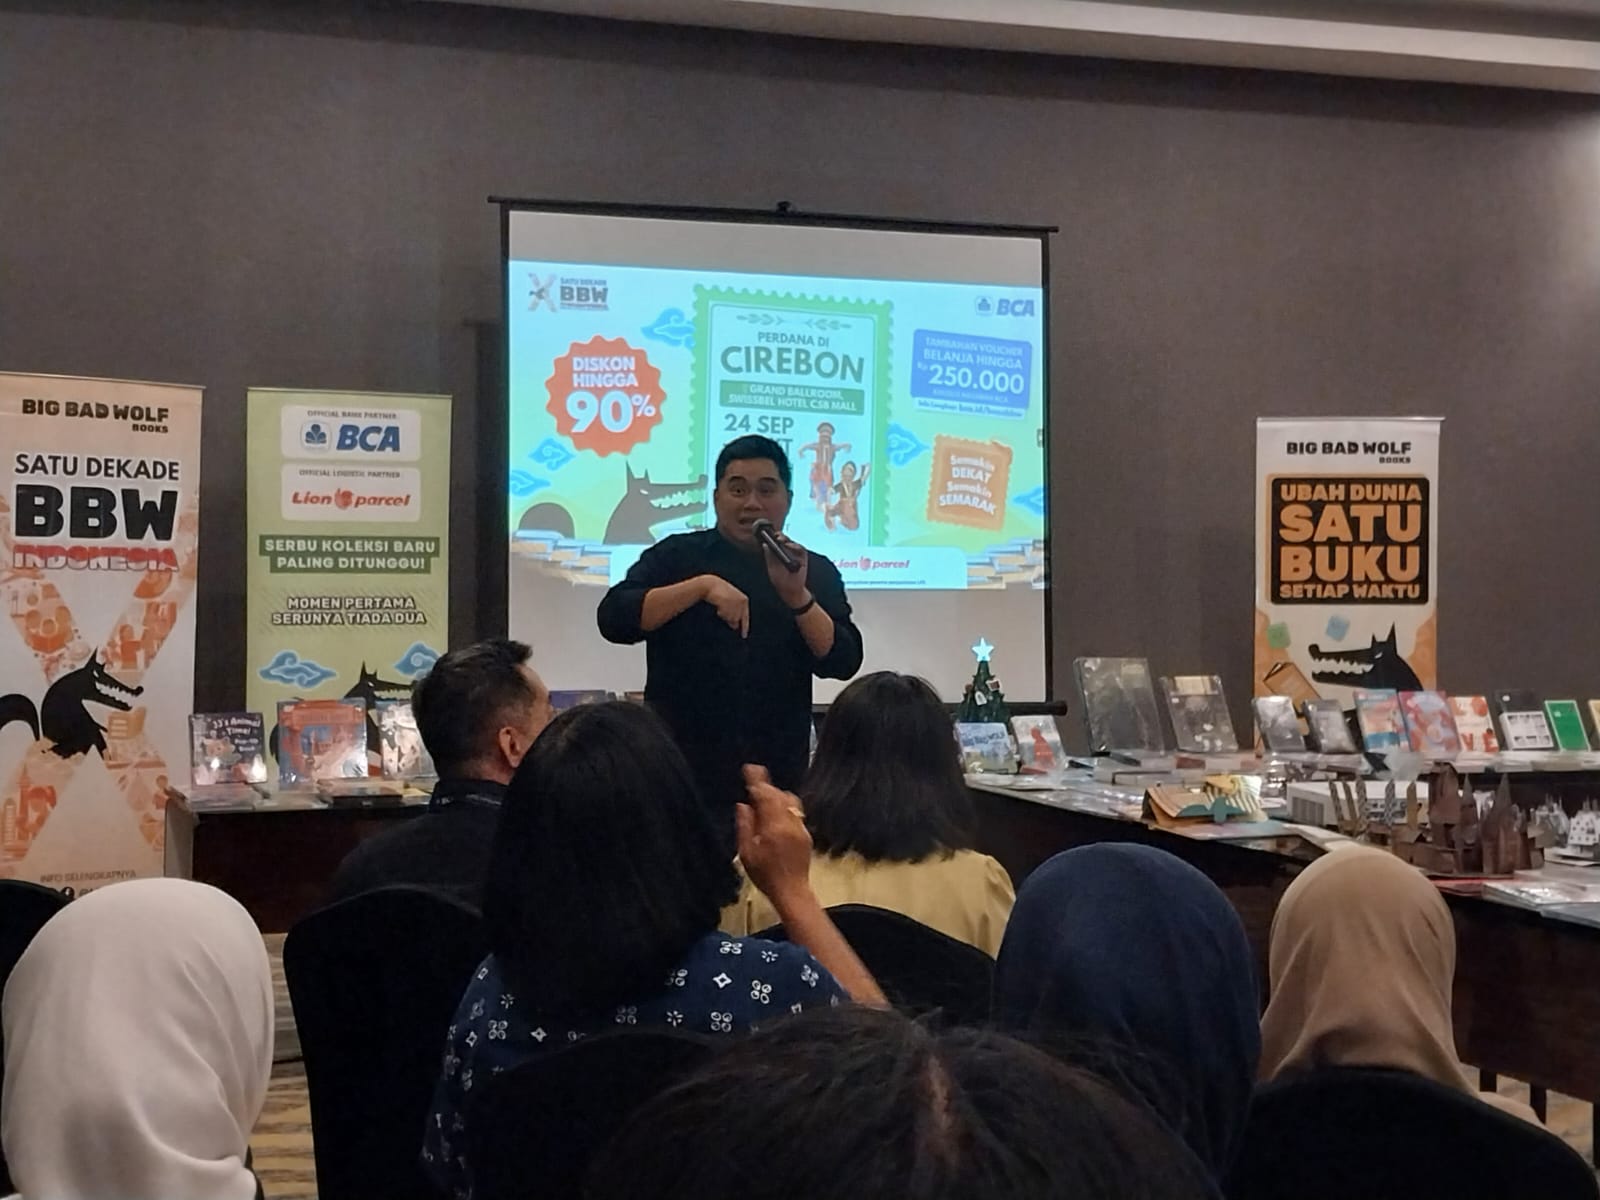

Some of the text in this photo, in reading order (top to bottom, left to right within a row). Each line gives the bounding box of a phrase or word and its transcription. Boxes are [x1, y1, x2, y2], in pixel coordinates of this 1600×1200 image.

[560, 286, 608, 303] BBW
[997, 298, 1035, 317] BCA
[757, 331, 830, 347] PERDANA DI
[925, 336, 1024, 356] TAMBAHAN VOUCHER
[573, 356, 635, 371] DISKON
[720, 345, 864, 383] CIREBON
[923, 348, 1023, 370] BELANJA HINGGA
[573, 372, 638, 388] HINGGA
[928, 364, 1025, 395] 250.000
[750, 384, 785, 396] GRAND
[22, 399, 169, 422] BIG BAD WOLF
[566, 389, 656, 433] 90%
[778, 397, 809, 408] HOTEL
[810, 398, 829, 409] CSB
[831, 401, 857, 411] MALL
[307, 410, 339, 418] OFFICIAL
[132, 423, 168, 433] BOOKS
[724, 413, 794, 434] 24 SEP
[336, 423, 400, 452] BCA
[1287, 442, 1411, 454] BIG BAD WOLF
[15, 453, 179, 480] SATU DEKADE
[1379, 456, 1411, 464] BOOKS
[952, 467, 992, 484] DEKAT
[292, 491, 411, 508] Lion parcel
[1280, 484, 1422, 501] UBAH DUNIA
[15, 484, 178, 541] BBW
[939, 493, 997, 516] SEMARAK
[1279, 503, 1422, 543] SATU
[265, 539, 435, 553] SERBU KOLEKSI BARU
[13, 544, 179, 572] INDONESIA
[277, 557, 425, 569] PALING DITUNGGU!
[832, 558, 910, 571] ion parcel
[1279, 545, 1420, 583] BUKU
[1279, 584, 1420, 599] SETIAP WAKTU
[287, 597, 415, 609] MOMEN PERTAMA
[272, 612, 426, 625] SERUNYA TIADA DUA
